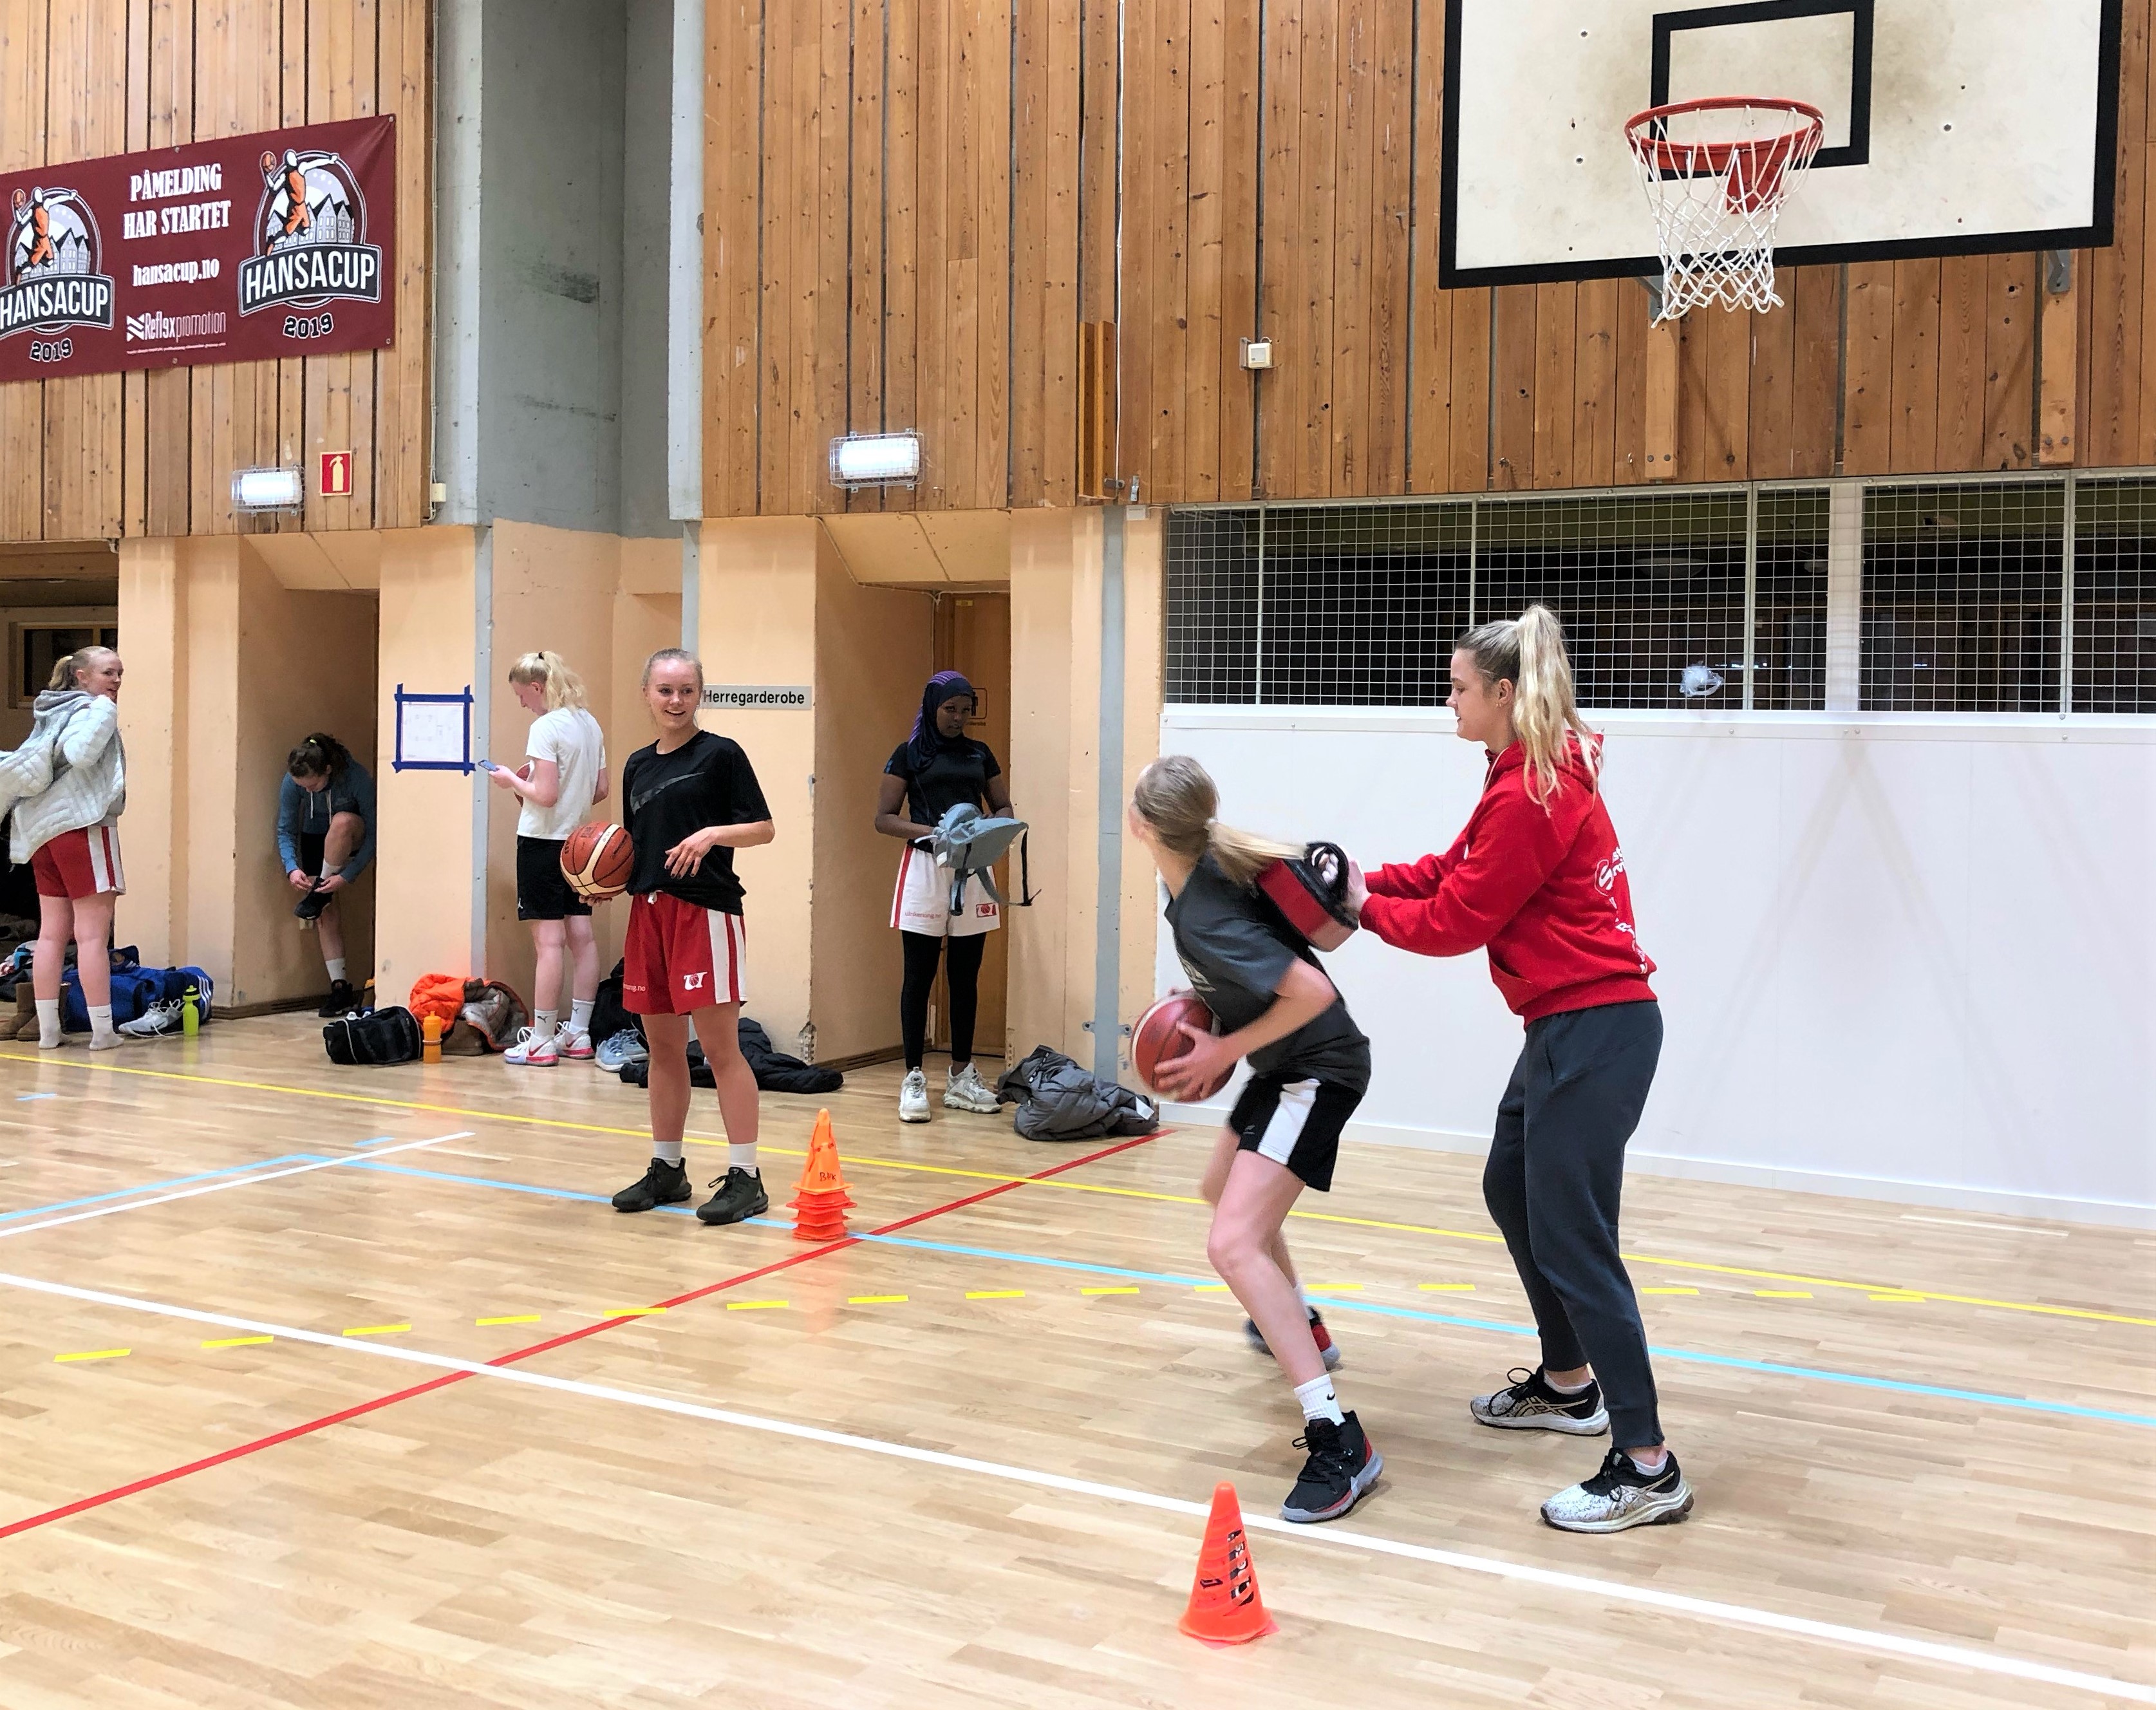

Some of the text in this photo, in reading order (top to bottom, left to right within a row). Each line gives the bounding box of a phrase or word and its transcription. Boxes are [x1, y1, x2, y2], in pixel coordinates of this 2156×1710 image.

[130, 163, 222, 202] PÅMELDING
[123, 200, 231, 240] HAR STARTET
[133, 258, 220, 287] hansacup.no
[246, 250, 375, 303] HANSACUP
[0, 281, 108, 330] HANSACUP
[283, 312, 333, 339] 2019
[30, 338, 73, 362] 2019
[703, 690, 805, 706] Herregarderobe
